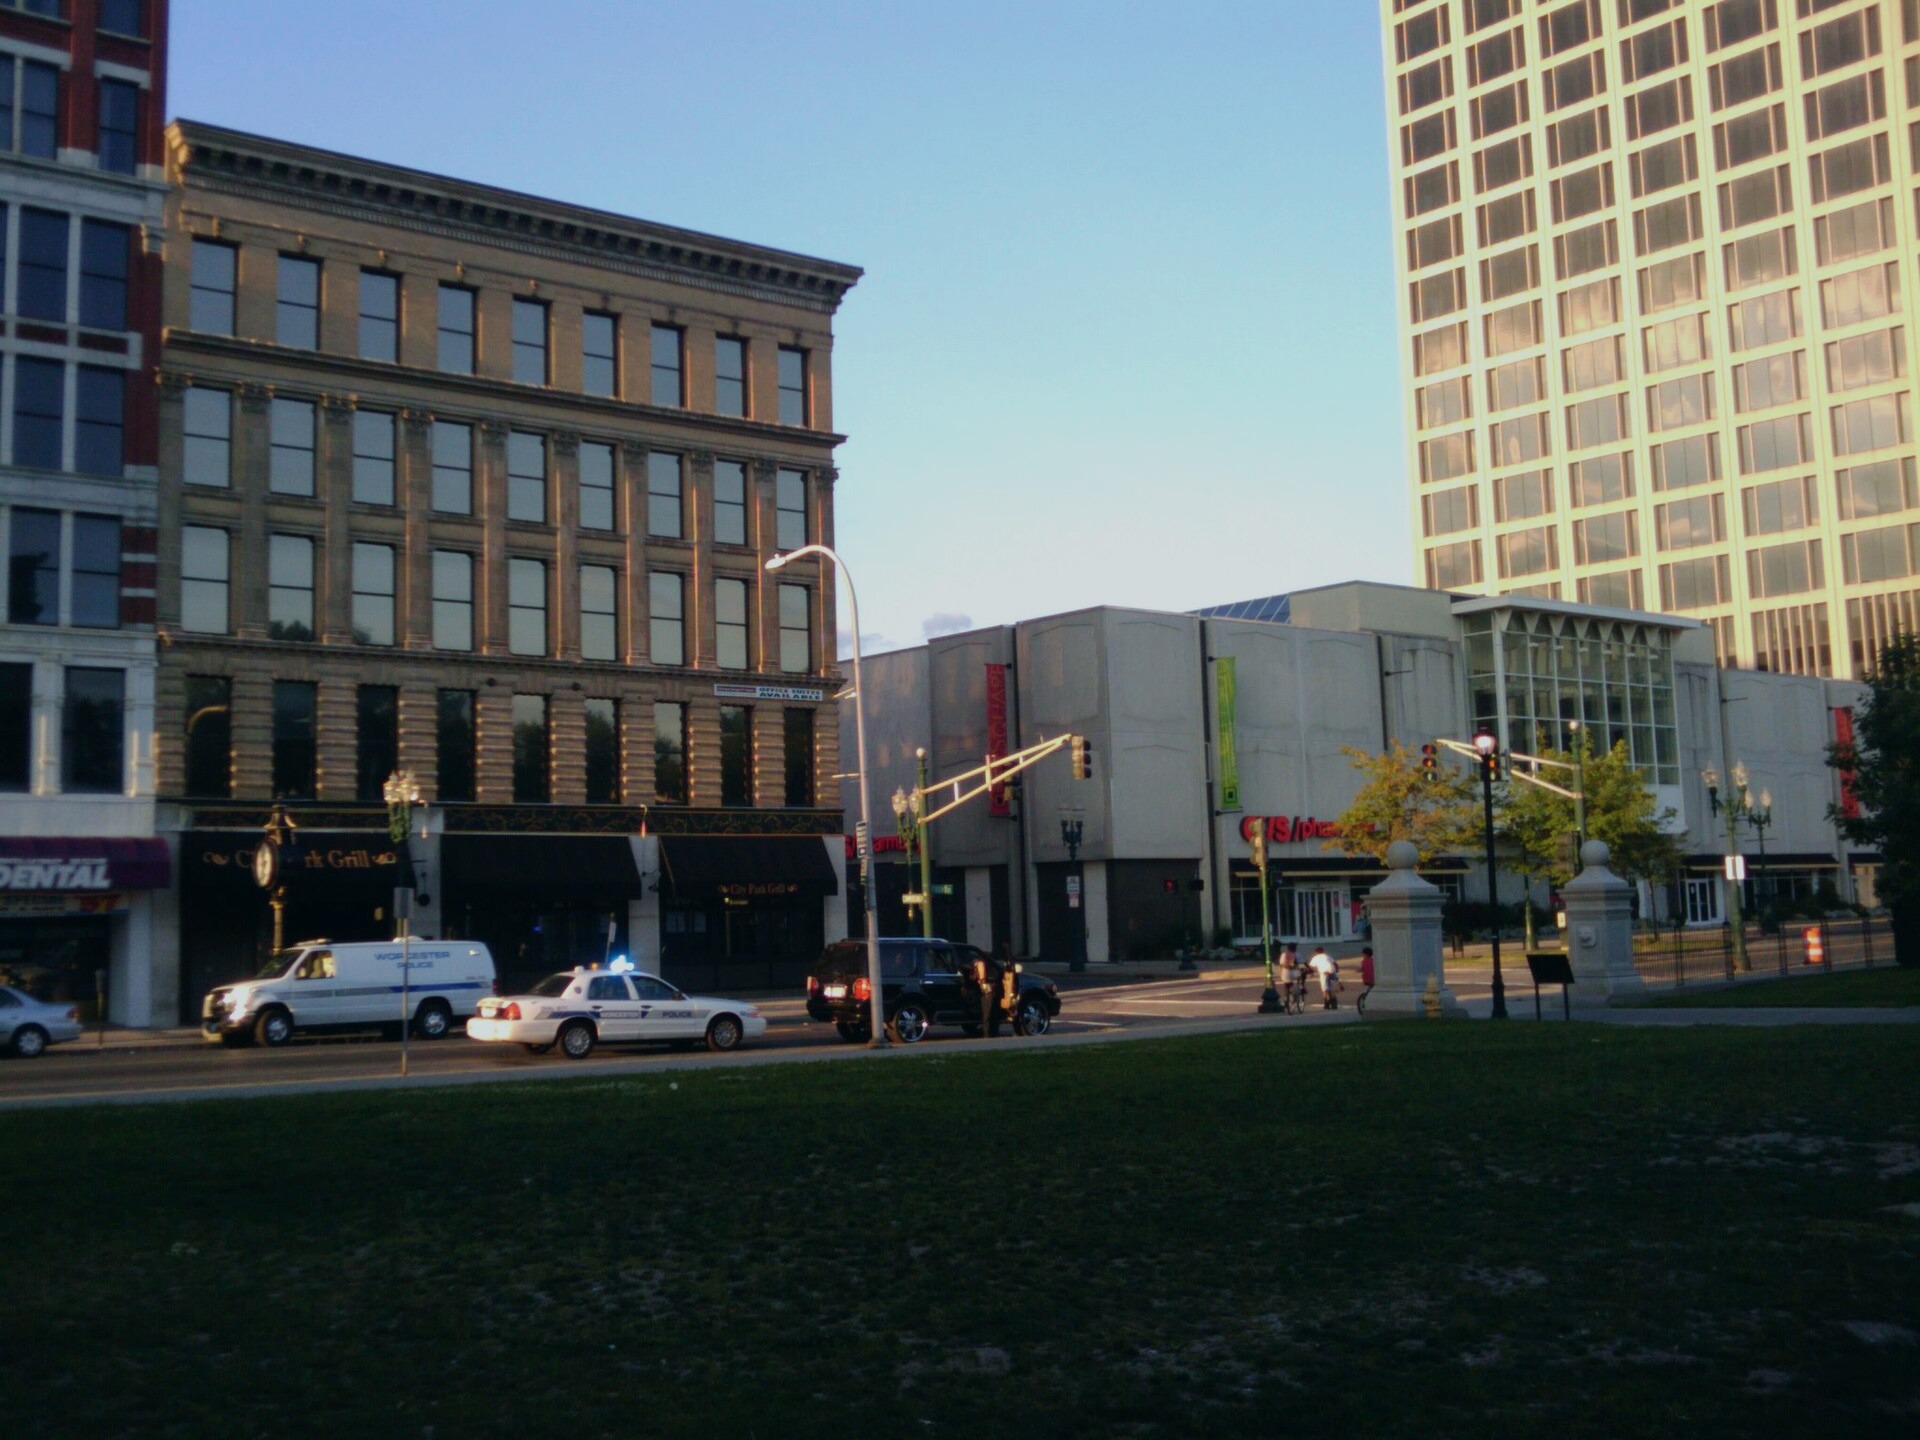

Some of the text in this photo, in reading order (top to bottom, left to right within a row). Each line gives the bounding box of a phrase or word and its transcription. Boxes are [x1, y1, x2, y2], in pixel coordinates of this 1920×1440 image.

[759, 692, 820, 700] AVAILABLE
[328, 849, 371, 868] Grill
[0, 863, 113, 889] DENTAL
[767, 883, 785, 894] Grill
[375, 951, 450, 960] WORCESTER
